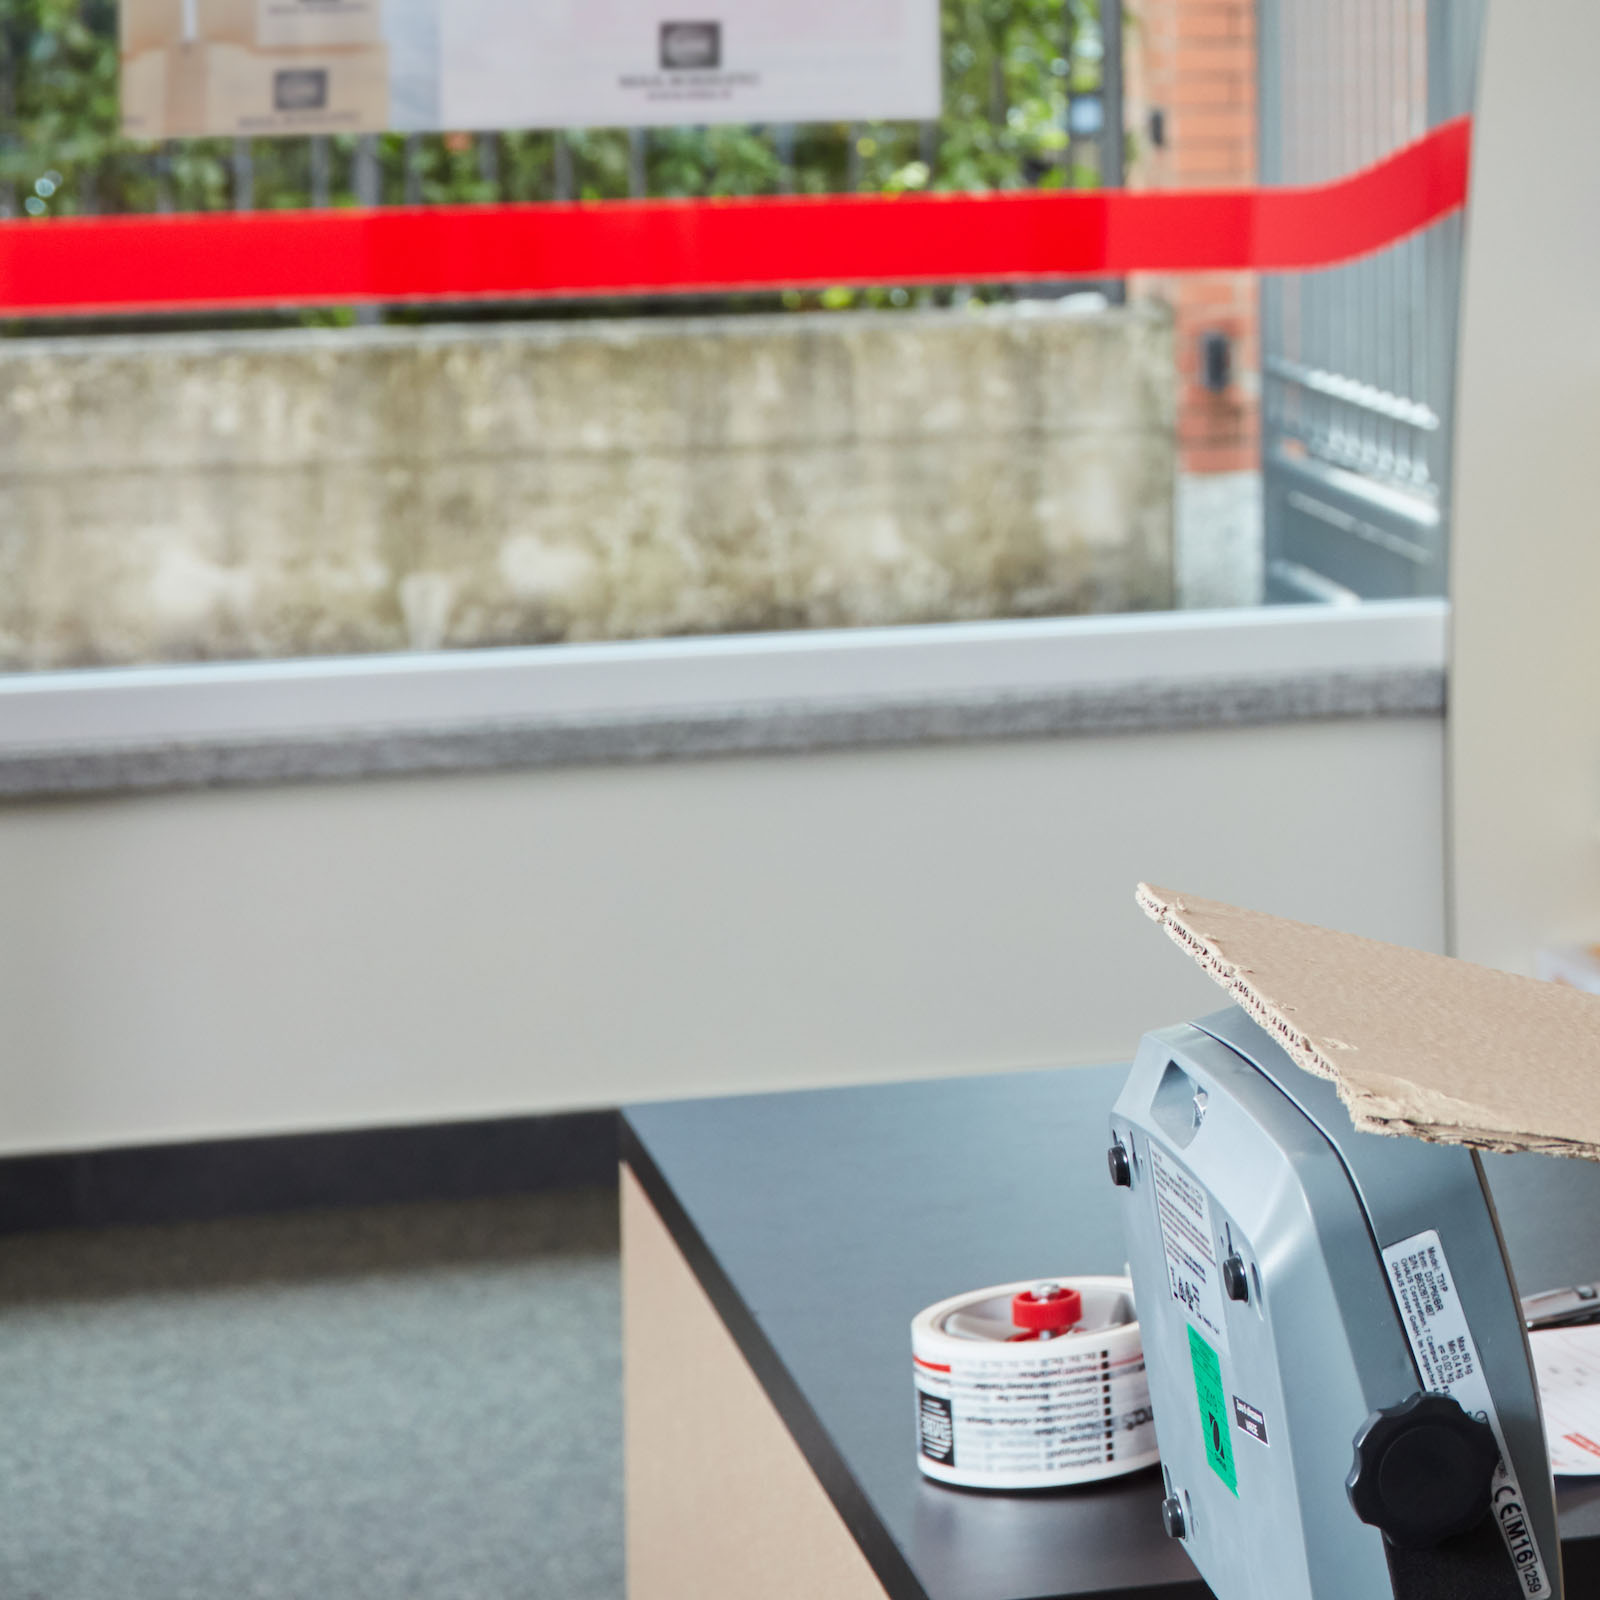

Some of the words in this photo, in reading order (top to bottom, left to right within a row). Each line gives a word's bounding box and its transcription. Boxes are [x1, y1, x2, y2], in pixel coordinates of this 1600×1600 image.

[1426, 1246, 1441, 1271] Model:
[1435, 1273, 1448, 1293] T31P
[1391, 1261, 1404, 1287] OHAUS
[1398, 1288, 1413, 1314] Europe
[1418, 1349, 1437, 1387] Langacher
[1399, 1257, 1414, 1284] OHAUS
[1424, 1335, 1440, 1363] Campus
[1435, 1364, 1447, 1384] Drive
[1446, 1340, 1457, 1355] Min
[1451, 1354, 1462, 1367] 0.4
[1456, 1336, 1467, 1352] Max
[1463, 1363, 1474, 1375] kg
[1440, 1354, 1452, 1372] 0.02
[1453, 1367, 1465, 1380] kg
[1444, 1372, 1456, 1384] kg
[1505, 1519, 1535, 1565] M16
[1522, 1564, 1542, 1593] 1259
